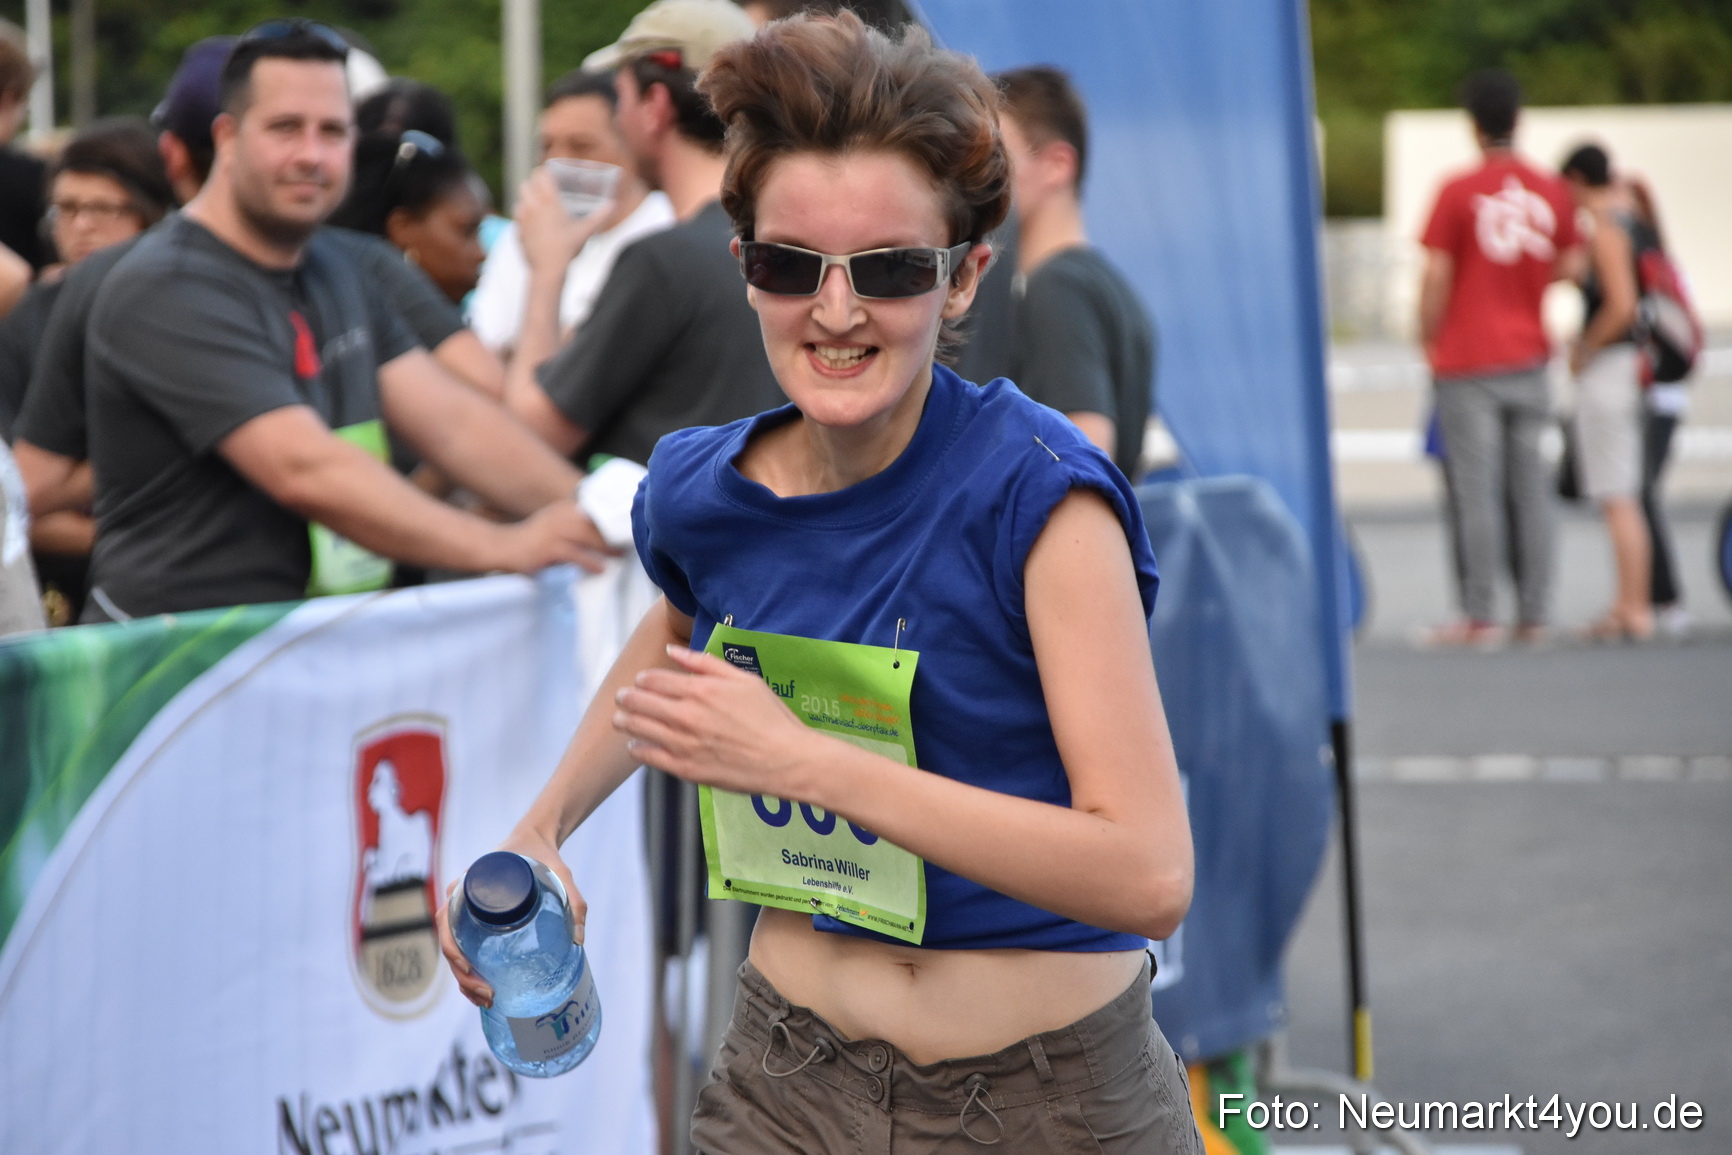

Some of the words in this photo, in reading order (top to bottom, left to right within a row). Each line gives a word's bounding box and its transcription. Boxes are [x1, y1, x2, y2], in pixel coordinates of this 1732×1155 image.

[730, 651, 753, 661] Fischer
[801, 694, 840, 718] 2015
[781, 848, 834, 872] Sabrina
[834, 858, 870, 881] Willer
[802, 876, 842, 891] Lebenshilfe
